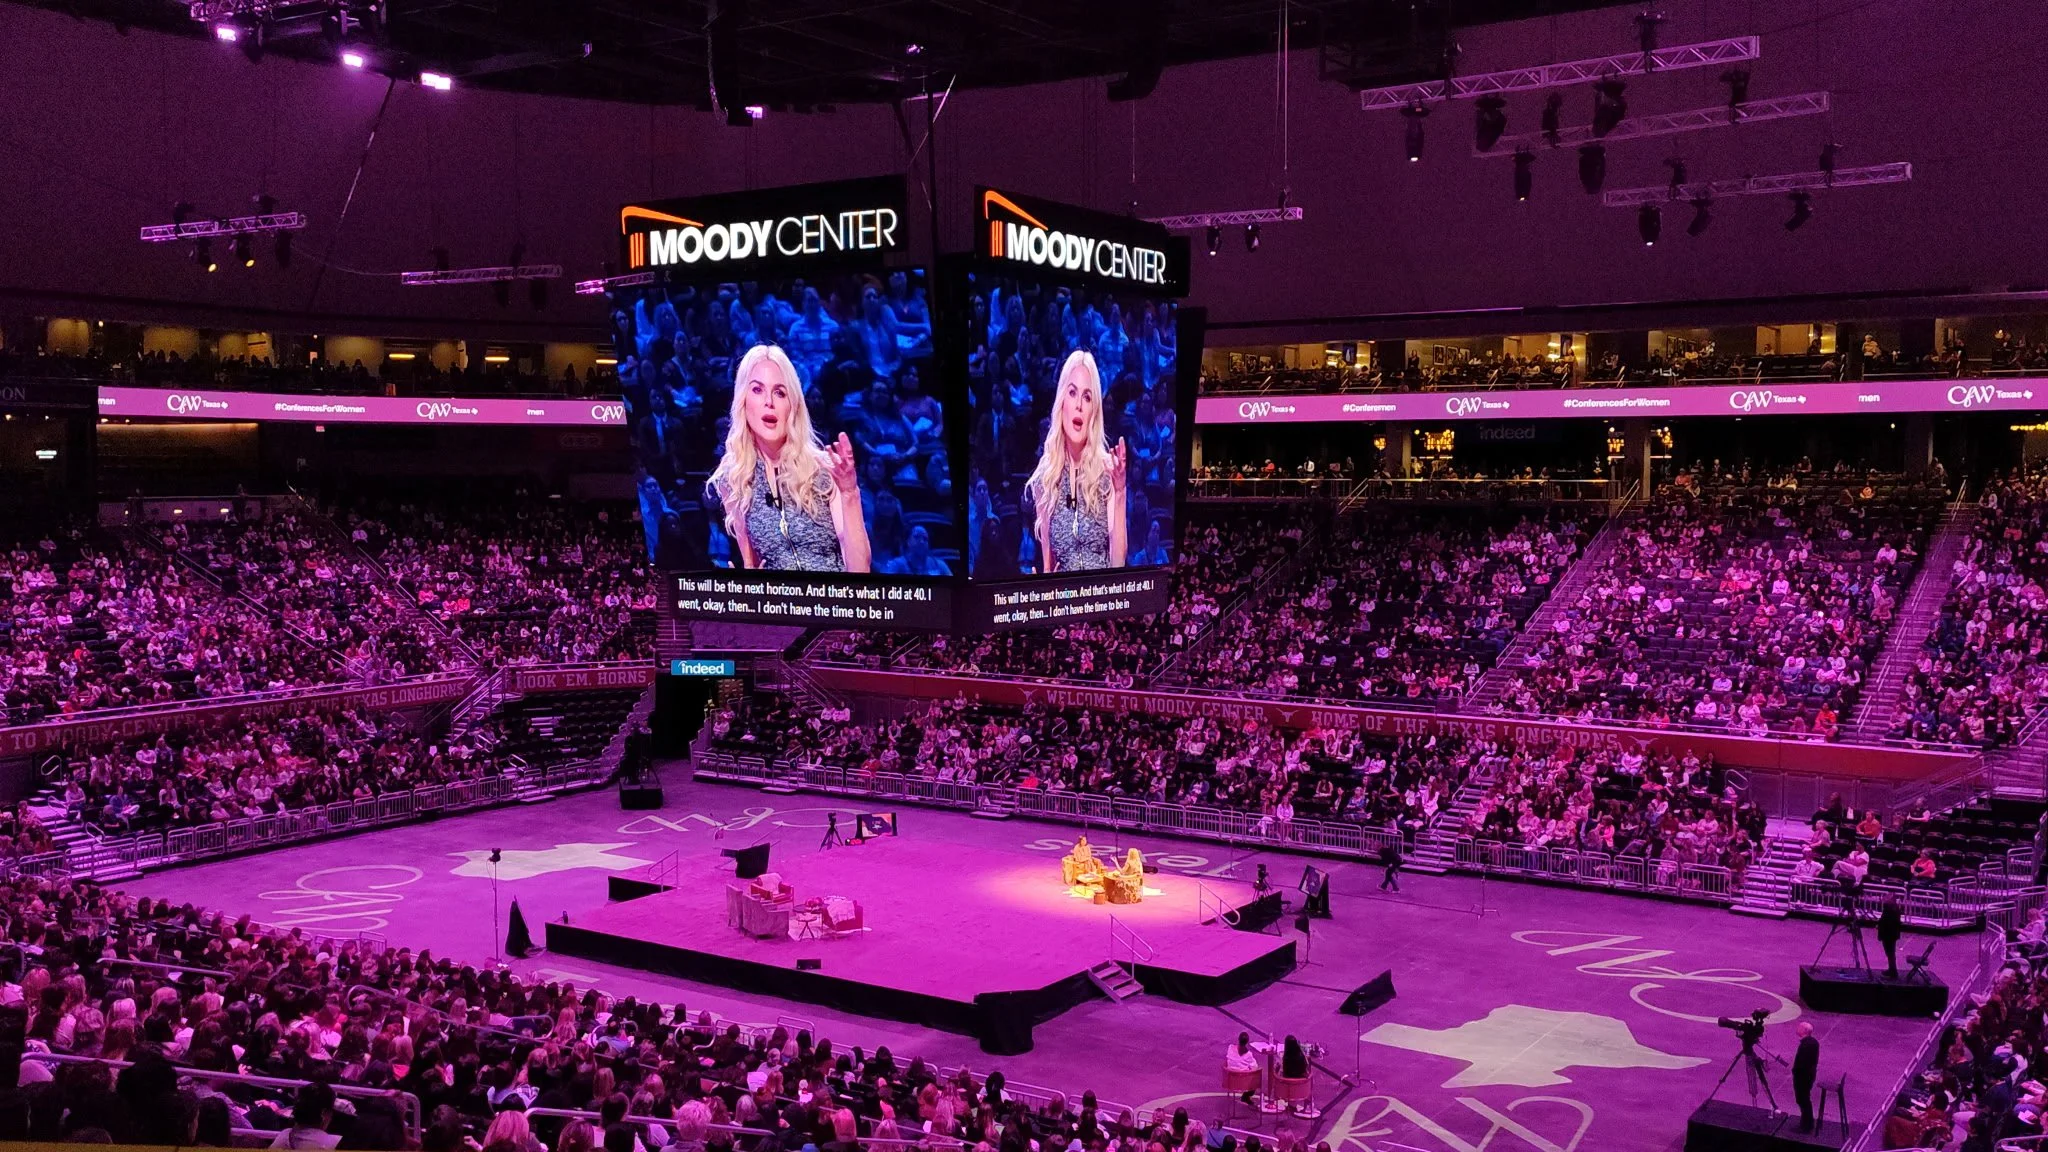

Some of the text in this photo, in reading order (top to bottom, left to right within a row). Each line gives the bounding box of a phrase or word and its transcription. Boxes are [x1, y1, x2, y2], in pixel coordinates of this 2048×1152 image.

[650, 208, 898, 266] MOODY CENTER
[1006, 222, 1166, 284] MOODY CENTER
[1773, 394, 1797, 404] Texas
[1996, 389, 2023, 399] Texas
[202, 401, 221, 409] Texas
[274, 402, 366, 413] #ConferencesForWomen
[1271, 405, 1289, 413] Texas
[1482, 401, 1502, 409] Texas
[1563, 398, 1671, 408] #ConferencesForWomen
[1477, 423, 1536, 440] indeed
[678, 578, 695, 591] This
[697, 579, 712, 591] will
[714, 580, 725, 592] be
[727, 580, 742, 593] the
[745, 583, 764, 594] next
[767, 582, 803, 596] horizon.
[806, 584, 825, 597] And
[828, 585, 854, 598] that's
[856, 586, 879, 599] what
[888, 587, 902, 599] did
[904, 589, 912, 600] at
[914, 588, 926, 600] 40.
[994, 594, 1007, 605] This
[1008, 592, 1018, 604] will
[1020, 592, 1028, 603] be
[1030, 591, 1040, 602] the
[1041, 590, 1054, 601] next
[1080, 586, 1091, 597] And
[1093, 585, 1108, 595] that's
[1109, 583, 1122, 594] what
[1126, 581, 1136, 592] did
[1136, 582, 1142, 591] at
[678, 599, 700, 611] went,
[703, 598, 725, 613] okay,
[728, 599, 755, 612] then...
[763, 601, 787, 614] don't
[790, 602, 812, 615] have
[814, 604, 830, 616] the
[832, 605, 853, 618] time
[856, 607, 867, 618] to
[869, 606, 882, 619] be
[885, 607, 893, 619] in
[1053, 605, 1069, 616] don't
[1070, 604, 1083, 614] have
[1084, 602, 1094, 613] the
[1095, 602, 1108, 612] time
[1109, 601, 1115, 610] to
[1115, 599, 1124, 609] be
[1124, 599, 1129, 608] in
[679, 660, 725, 675] indeed
[597, 670, 647, 685] HORNS
[391, 683, 465, 704] LONGHORNS
[1046, 689, 1115, 708] WELCOME
[1120, 695, 1138, 710] TO
[1143, 697, 1196, 715] MOODY
[1202, 701, 1264, 720] CENTER
[1311, 710, 1359, 729] HOME
[1365, 715, 1386, 731] OF
[11, 732, 37, 750] TO
